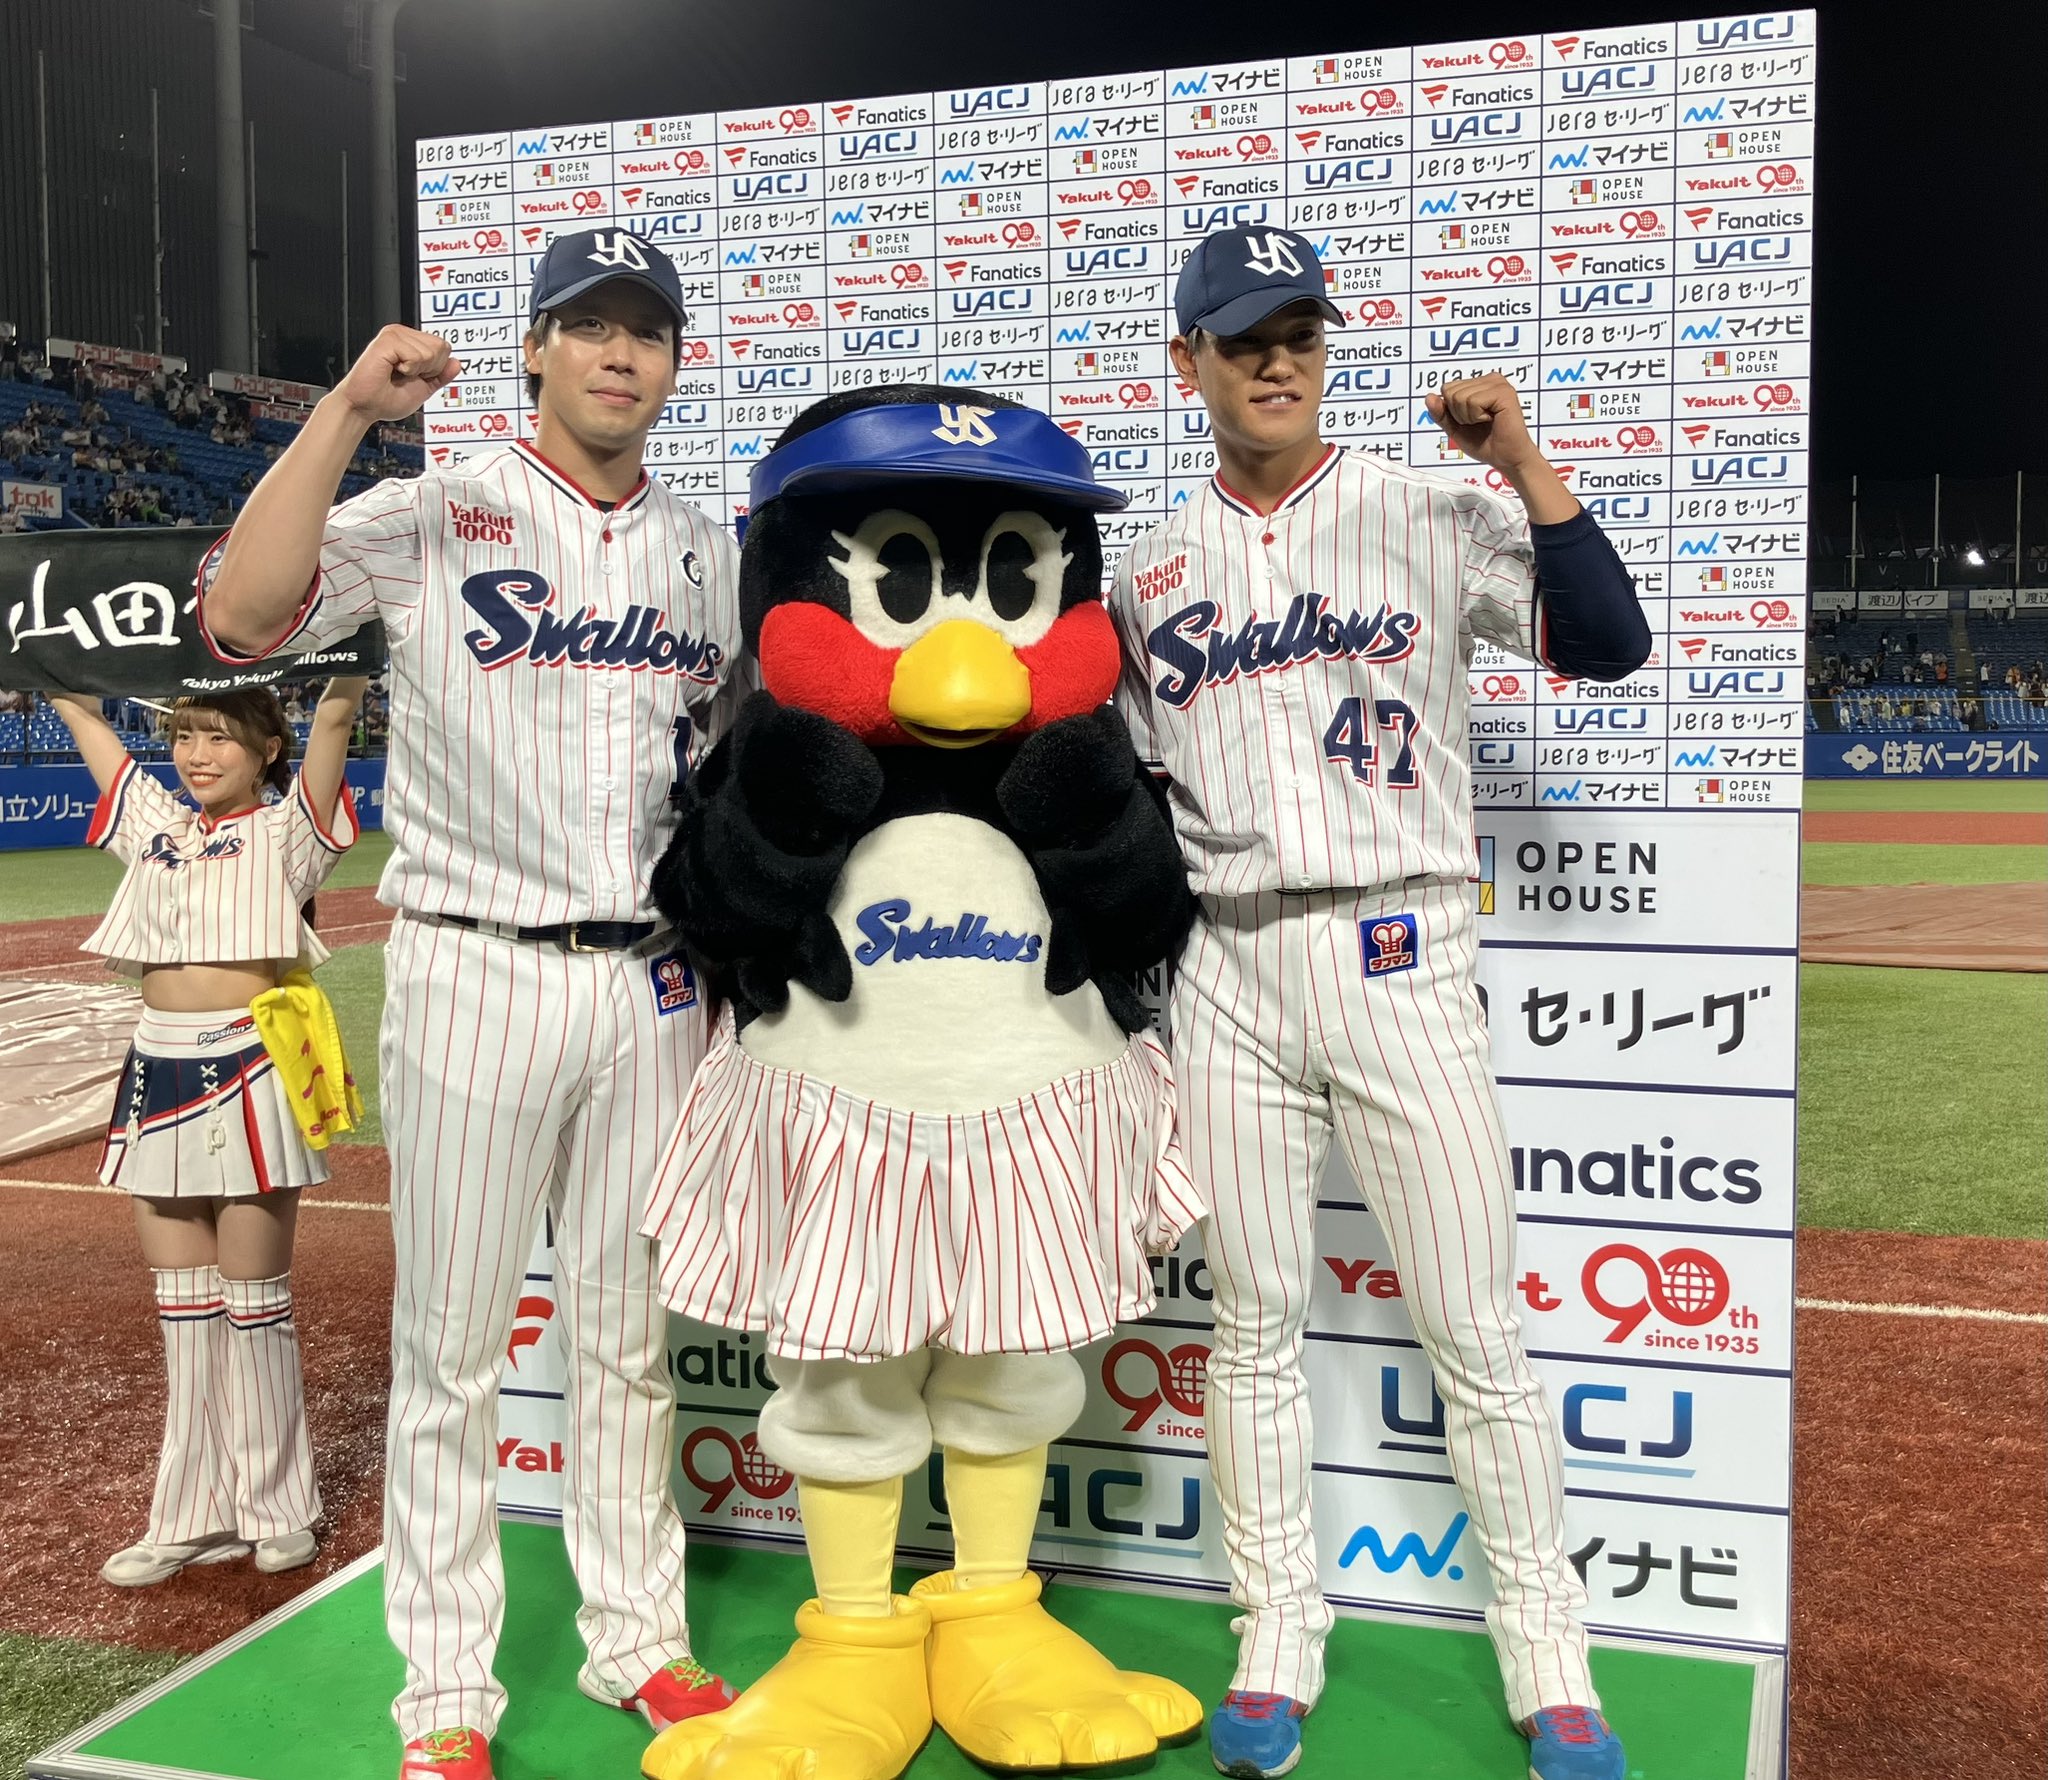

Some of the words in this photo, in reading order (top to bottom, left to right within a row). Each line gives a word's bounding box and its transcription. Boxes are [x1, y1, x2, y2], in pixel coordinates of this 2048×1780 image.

[1696, 15, 1793, 51] UACJ
[1344, 56, 1382, 68] OPEN
[1422, 54, 1484, 68] Yakult
[1212, 68, 1280, 92] マイナビ
[1345, 69, 1382, 80] HOUSE
[1561, 65, 1655, 99] UACJ
[950, 87, 1030, 119] UACJ
[1296, 101, 1356, 115] Yakult
[1729, 94, 1806, 119] マイナビ
[660, 121, 691, 132] OPEN
[1093, 114, 1159, 137] マイナビ
[661, 132, 691, 142] HOUSE
[840, 131, 917, 161] UACJ
[1739, 130, 1780, 143] OPEN
[750, 148, 817, 168] Fanatics
[1174, 146, 1232, 160] Yakult
[1740, 144, 1780, 155] HOUSE
[1304, 158, 1392, 191] UACJ
[1603, 177, 1642, 189] OPEN
[1685, 176, 1751, 190] Yakult
[1203, 176, 1278, 197] Fanatics
[1603, 190, 1642, 201] HOUSE
[460, 202, 490, 212] OPEN
[1057, 191, 1113, 204] Yakult
[1461, 188, 1534, 211] マイナビ
[461, 213, 490, 221] HOUSE
[867, 201, 929, 222] マイナビ
[1718, 209, 1803, 230] Fanatics
[1551, 222, 1615, 236] Yakult
[424, 240, 471, 251] Yakult
[1694, 237, 1791, 270] UACJ
[1066, 246, 1148, 276] UACJ
[1582, 254, 1665, 275] Fanatics
[834, 274, 887, 286] Yakult
[432, 291, 501, 318] UACJ
[861, 303, 929, 321] Fanatics
[1451, 298, 1531, 319] Fanatics
[728, 313, 779, 325] Yakult
[1094, 319, 1159, 339] マイナビ
[1726, 315, 1803, 338] マイナビ
[1103, 352, 1138, 361] OPEN
[1325, 342, 1402, 361] Fanatics
[1736, 350, 1777, 362] OPEN
[1104, 364, 1138, 372] HOUSE
[1590, 358, 1665, 381] マイナビ
[1737, 363, 1777, 373] HOUSE
[738, 367, 812, 393] UACJ
[465, 386, 495, 395] OPEN
[466, 397, 495, 405] HOUSE
[1682, 395, 1748, 408] Yakult
[1548, 437, 1612, 449] Yakult
[1715, 428, 1800, 447] Fanatics
[1691, 456, 1787, 485] UACJ
[447, 500, 517, 532] Yakult
[451, 519, 513, 546] 1000
[1133, 554, 1188, 591] Yakult
[1733, 567, 1774, 577] OPEN
[1138, 571, 1184, 604] 1000
[1733, 580, 1774, 589] HOUSE
[1679, 610, 1745, 621] Yakult
[461, 569, 724, 686] Swallows
[1147, 592, 1422, 711] Swallows
[182, 678, 232, 691] Tokyo
[1688, 672, 1784, 697] UACJ
[1322, 696, 1420, 789] 47
[1720, 748, 1796, 766] マイナビ
[1881, 740, 2040, 774] 住友ベークライト
[1585, 783, 1659, 801] マイナビ
[0, 793, 97, 823] 立ソリュー
[1515, 840, 1657, 876] OPEN
[1517, 885, 1657, 914] HOUSE
[854, 899, 1043, 967] Swallows
[1511, 1136, 1762, 1205] natics
[1643, 1331, 1699, 1351] since
[1703, 1333, 1759, 1356] 1935
[730, 1502, 773, 1521] since
